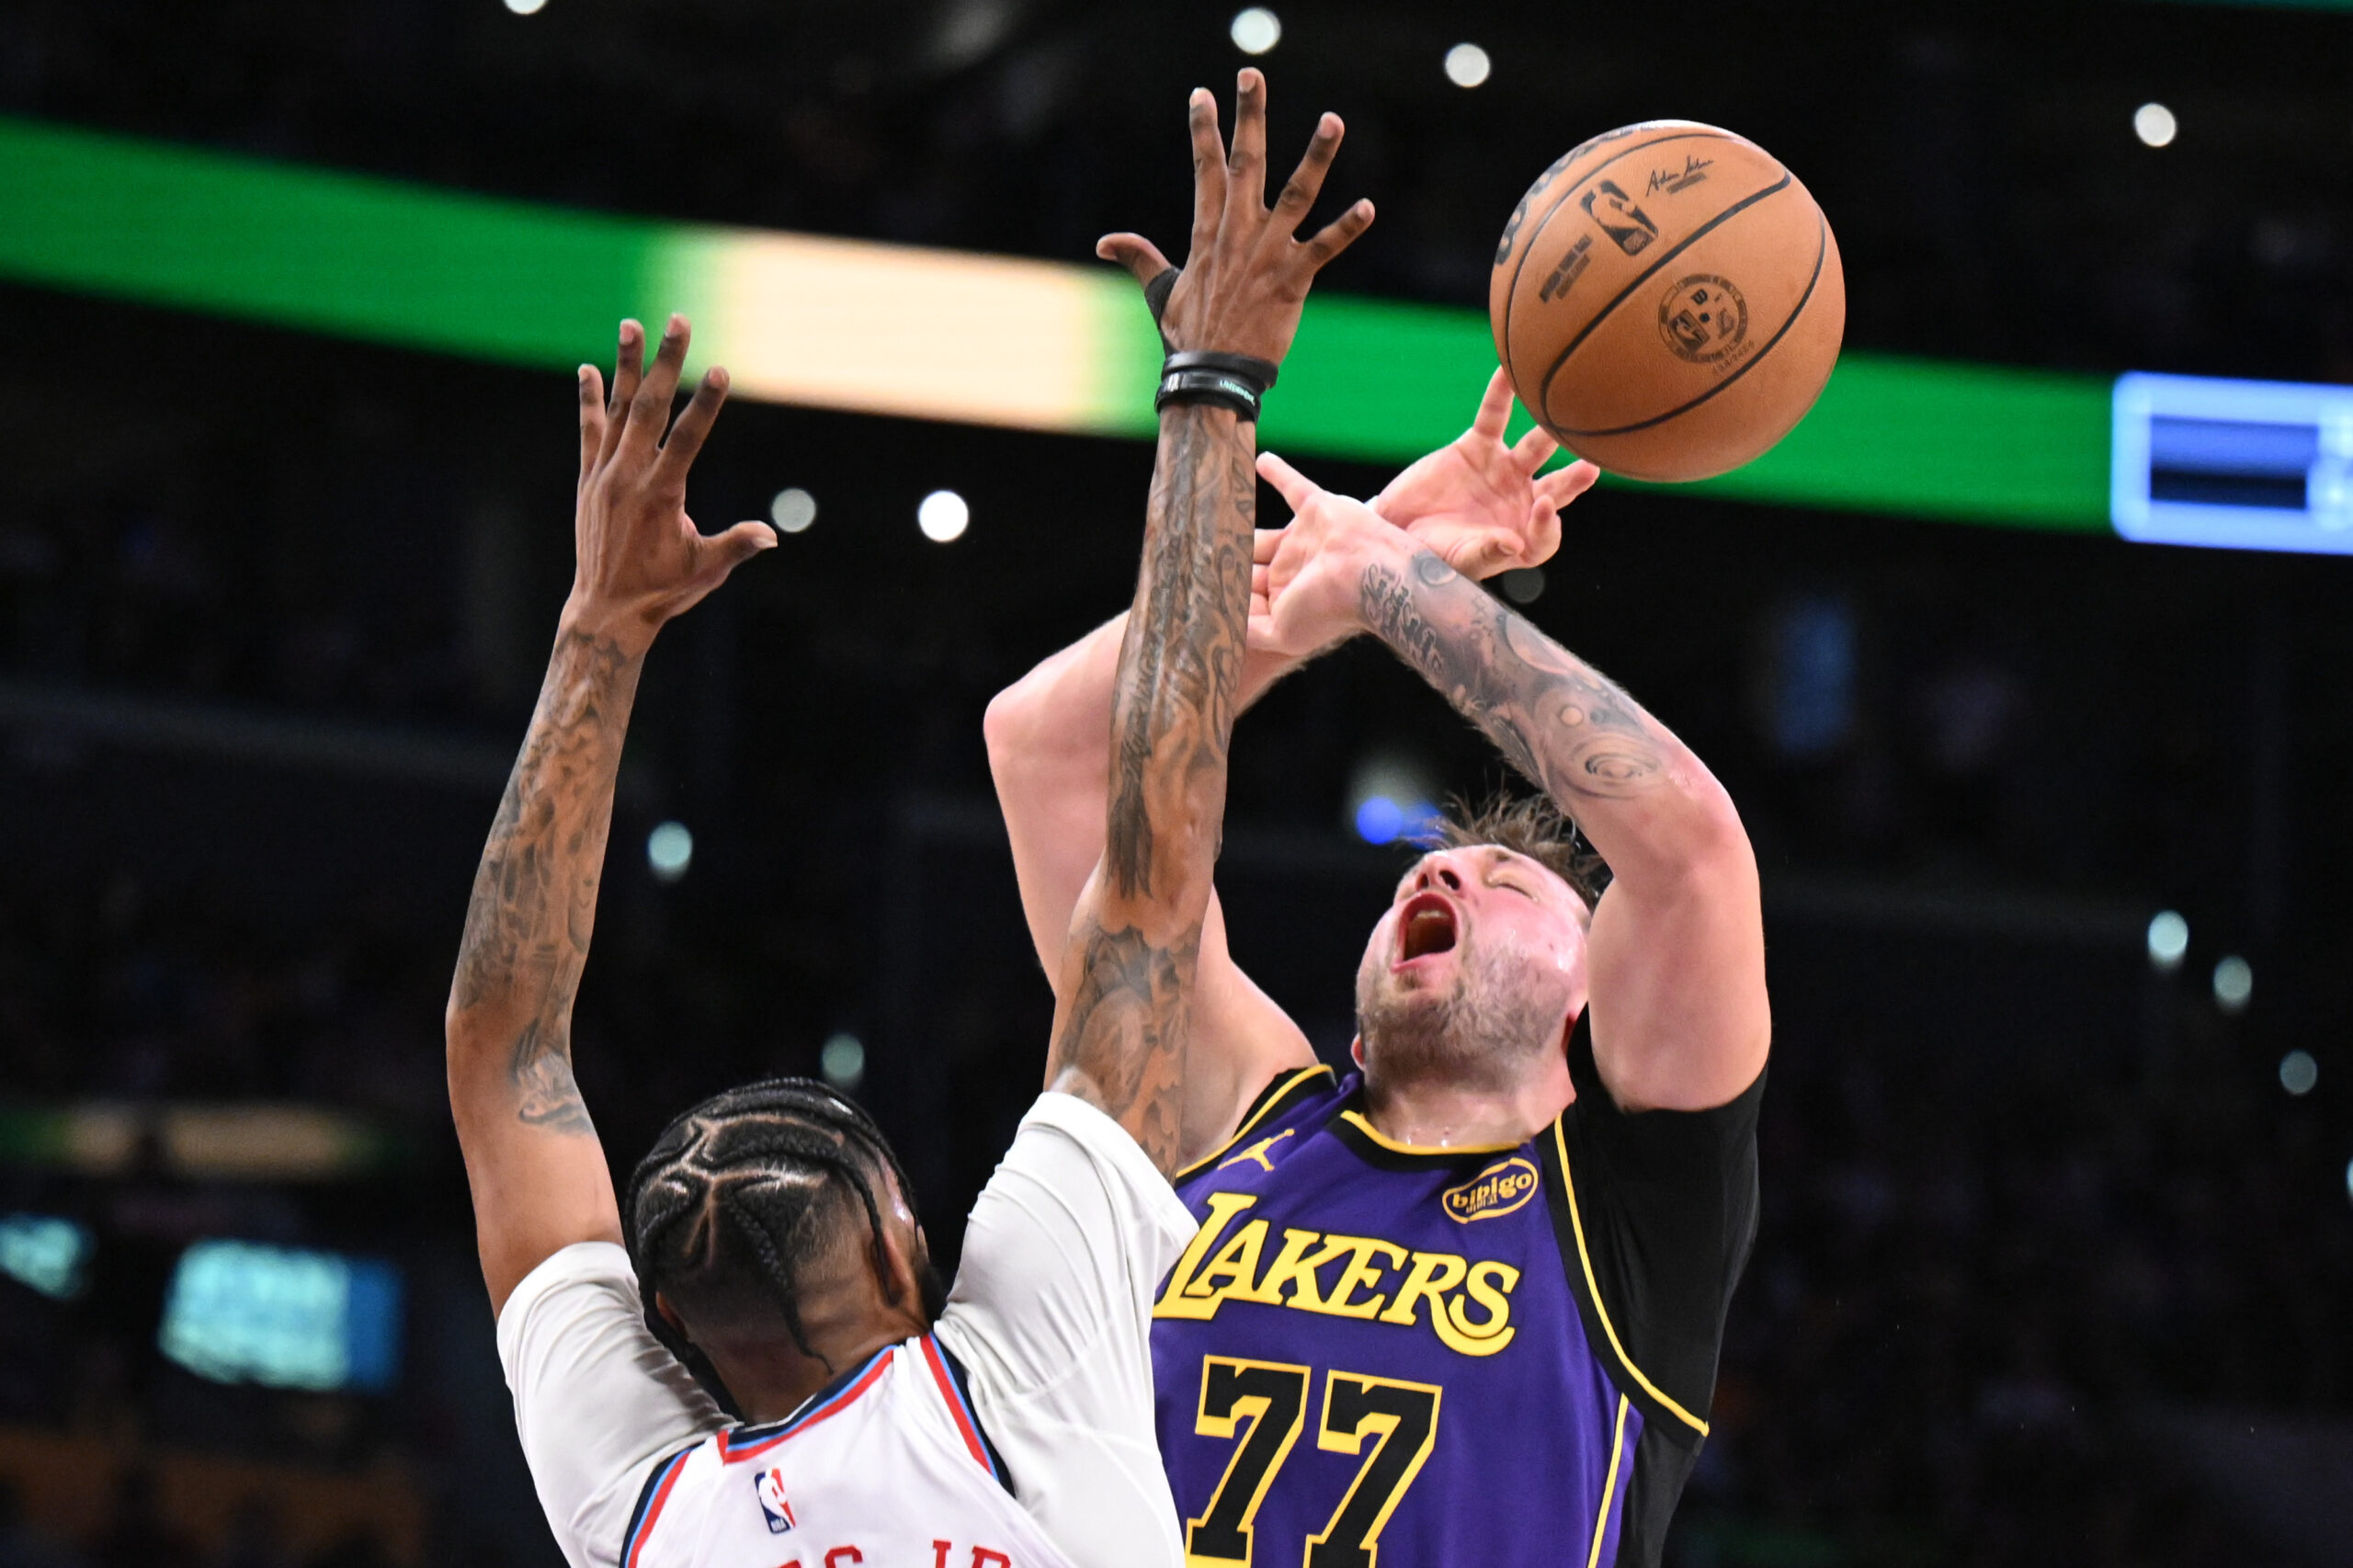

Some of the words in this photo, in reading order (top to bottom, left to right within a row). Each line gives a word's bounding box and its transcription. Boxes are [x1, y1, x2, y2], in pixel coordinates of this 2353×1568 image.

[1152, 1191, 1521, 1357] LAKERS
[1452, 1173, 1533, 1210] bibigo
[1184, 1354, 1443, 1568] 77
